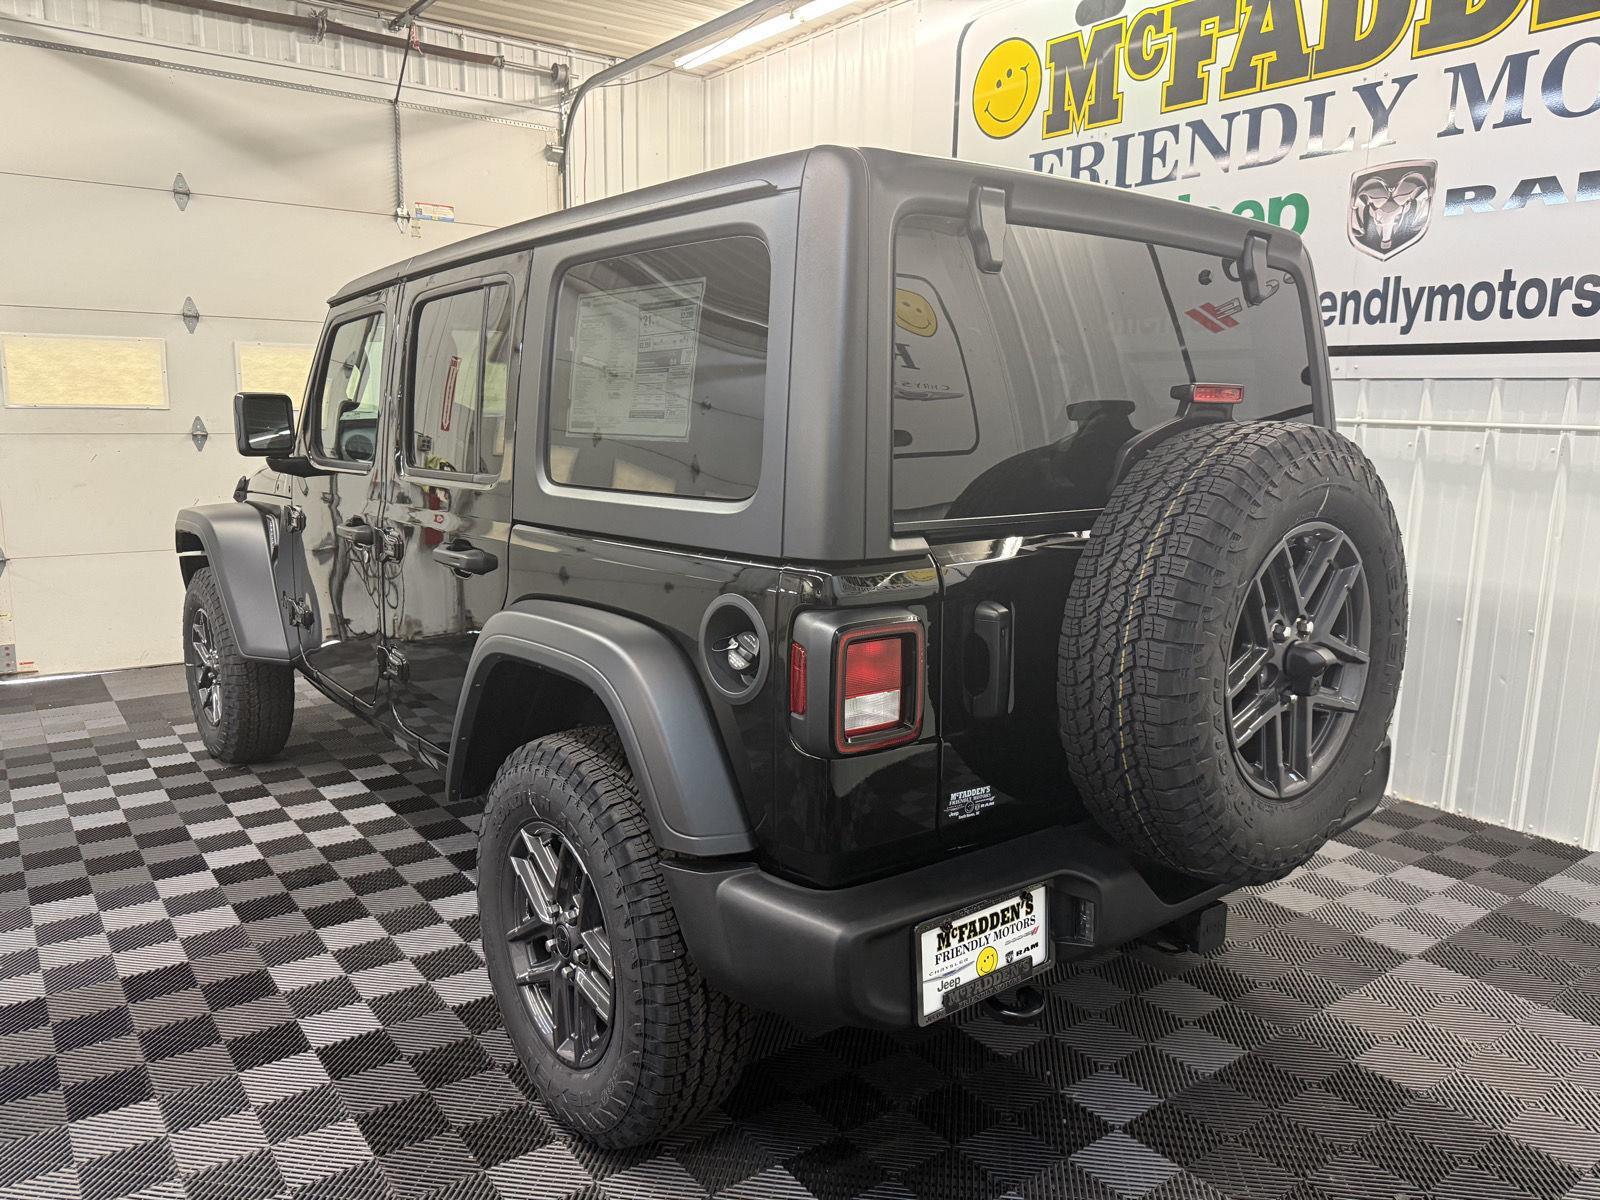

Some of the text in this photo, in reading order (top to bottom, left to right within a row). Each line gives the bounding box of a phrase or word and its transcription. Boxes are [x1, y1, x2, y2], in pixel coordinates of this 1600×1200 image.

[1042, 0, 1600, 140] McFAD
[1443, 170, 1600, 217] RA
[934, 934, 992, 966] FRIENDLY
[993, 915, 1036, 945] MOTORS
[936, 900, 1034, 952] McFADDEN'S
[1015, 942, 1039, 957] RAM
[937, 976, 961, 993] Jeep
